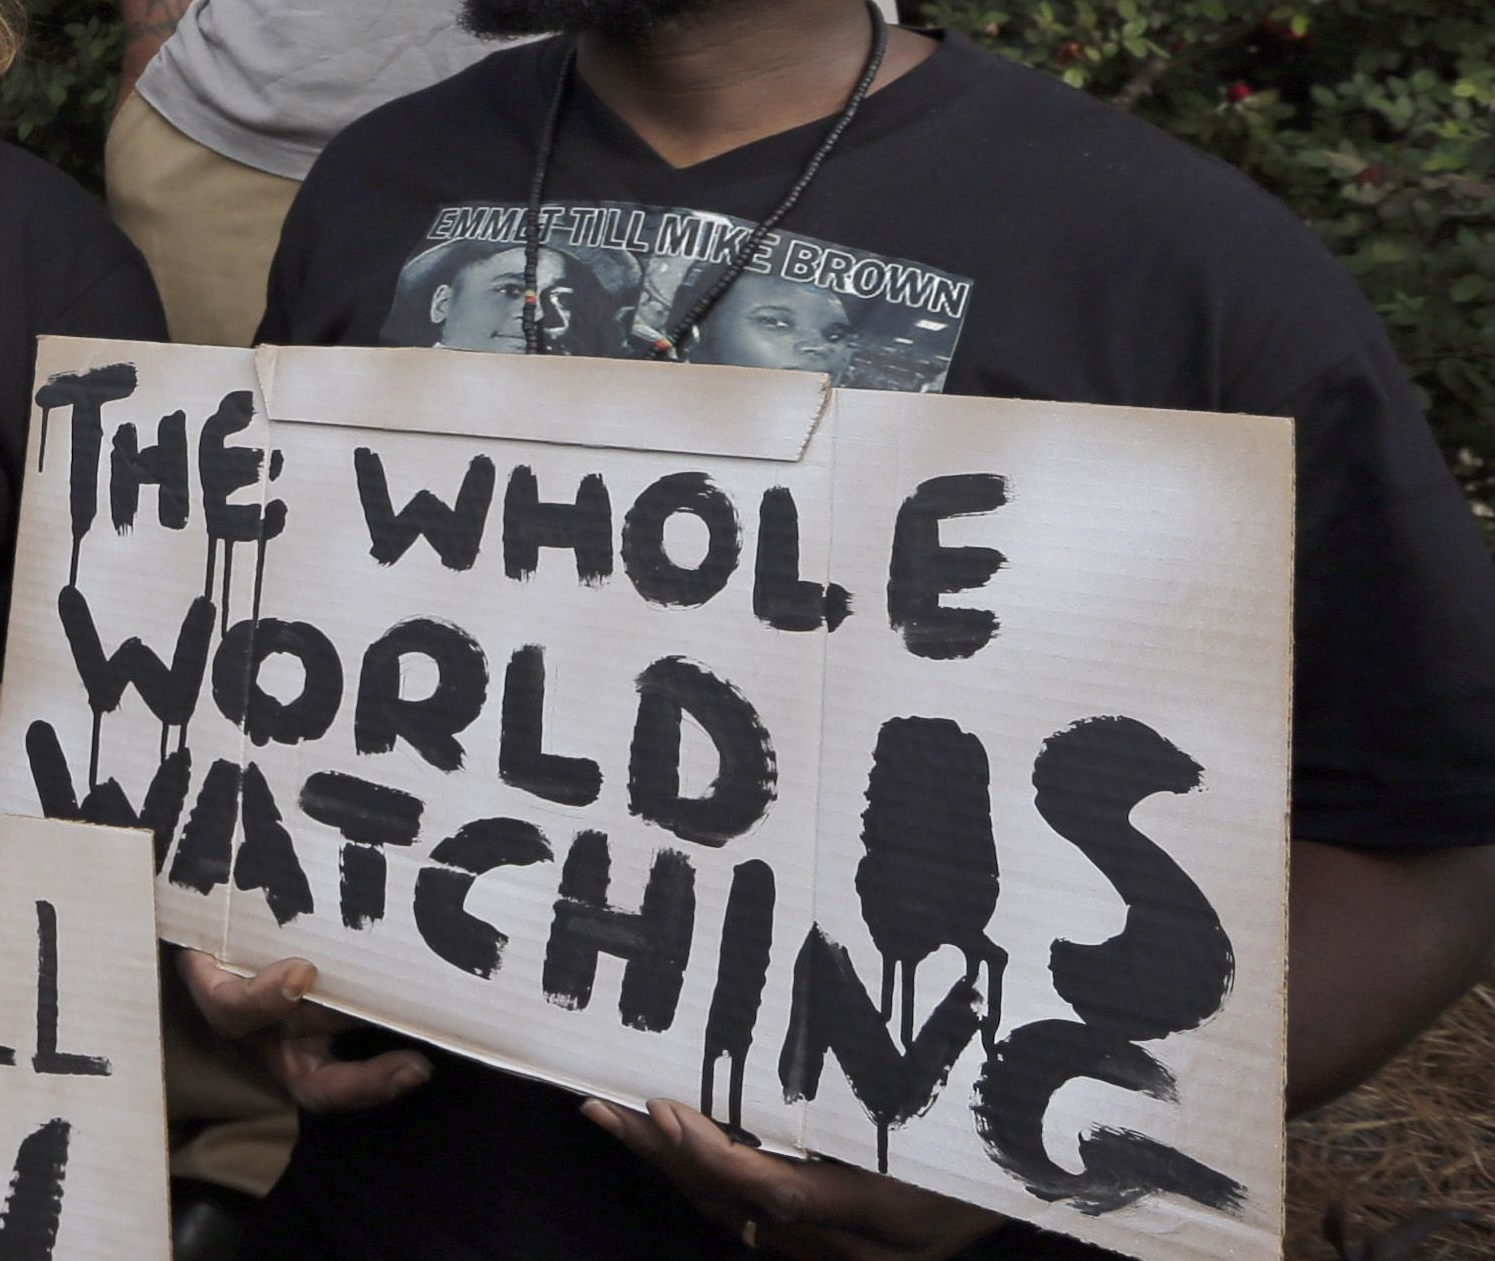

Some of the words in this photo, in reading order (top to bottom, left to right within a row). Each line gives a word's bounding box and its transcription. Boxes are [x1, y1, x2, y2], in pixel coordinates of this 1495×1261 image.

[569, 207, 650, 253] TILL
[655, 212, 782, 275] MIKE
[780, 238, 970, 319] BROWN
[34, 361, 288, 542] THE
[353, 445, 1012, 661] WHOLE
[24, 718, 1250, 1218] WATCHING
[57, 584, 779, 848] WORLD
[855, 714, 1238, 1043] IS
